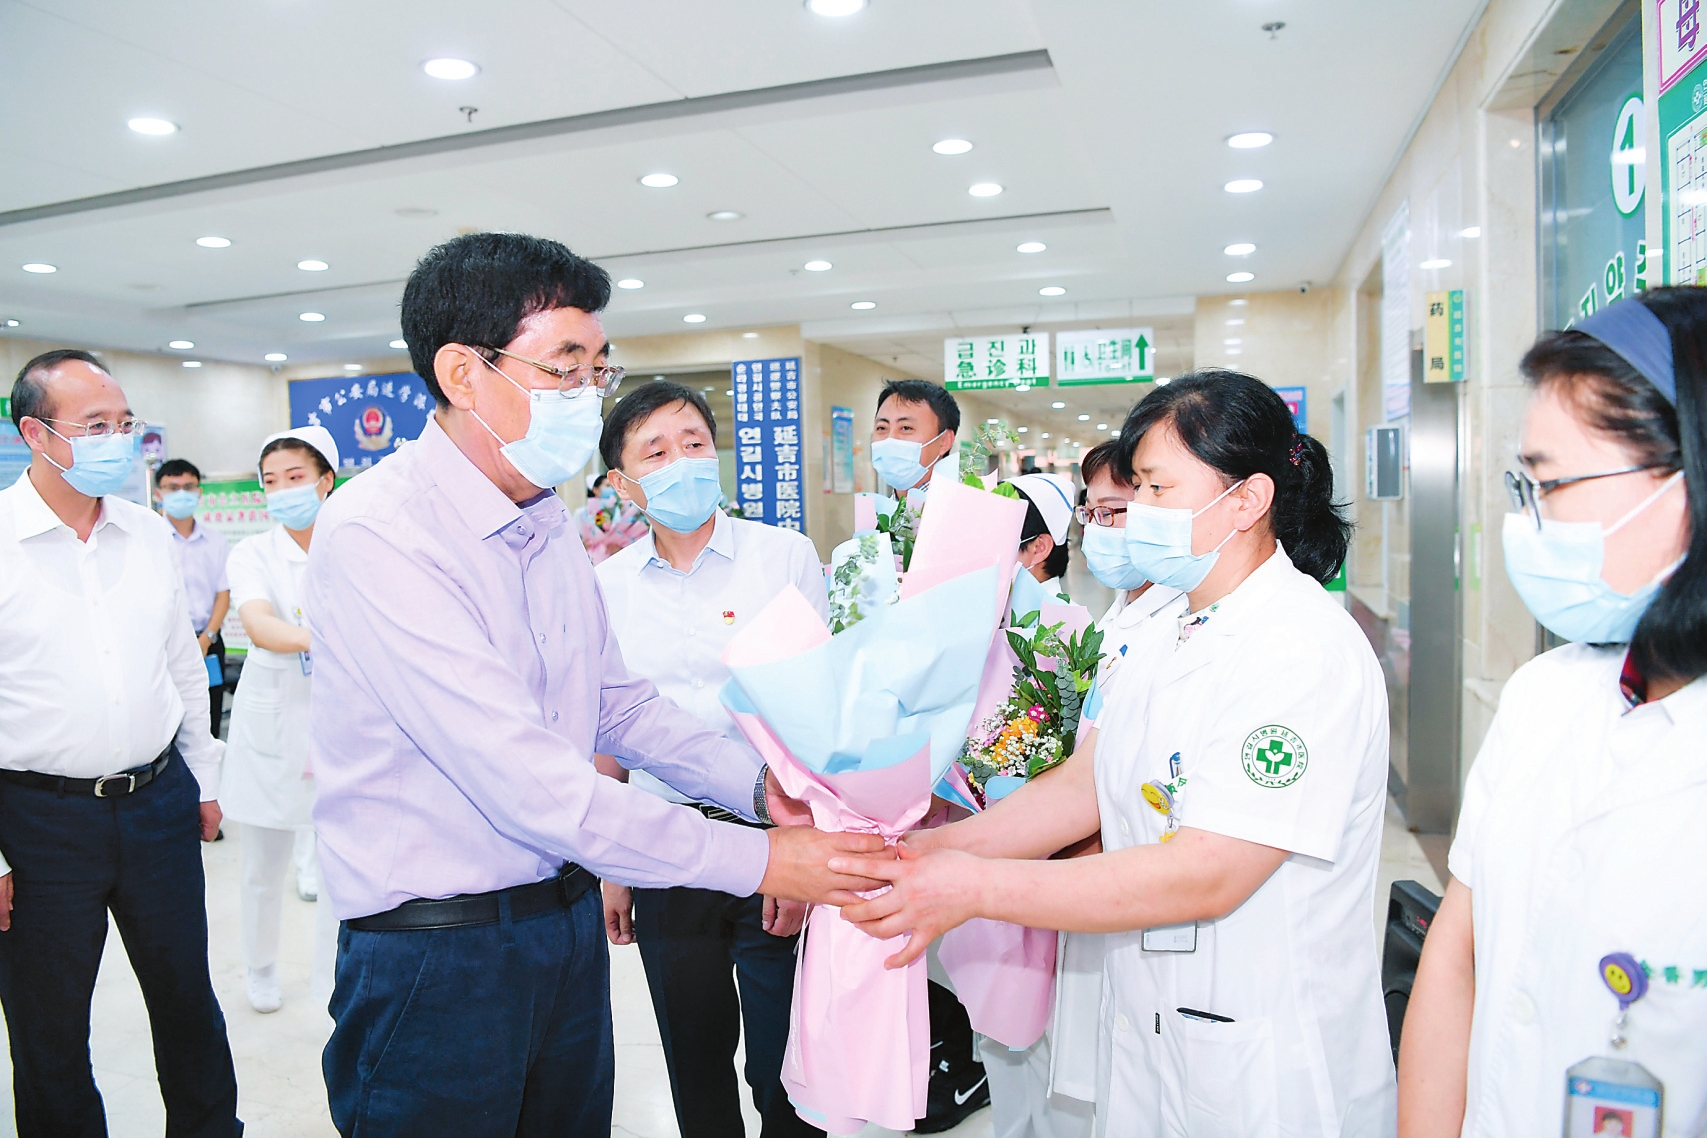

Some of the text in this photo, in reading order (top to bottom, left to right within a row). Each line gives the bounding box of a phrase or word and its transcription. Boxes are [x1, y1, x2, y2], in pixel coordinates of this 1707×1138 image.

[957, 338, 1036, 359] 급진과
[1430, 302, 1445, 370] 药局
[957, 358, 1037, 378] 急诊科
[957, 378, 1009, 390] Emergency
[785, 360, 798, 420] 延吉市公安局
[738, 427, 763, 518] 연길시병원
